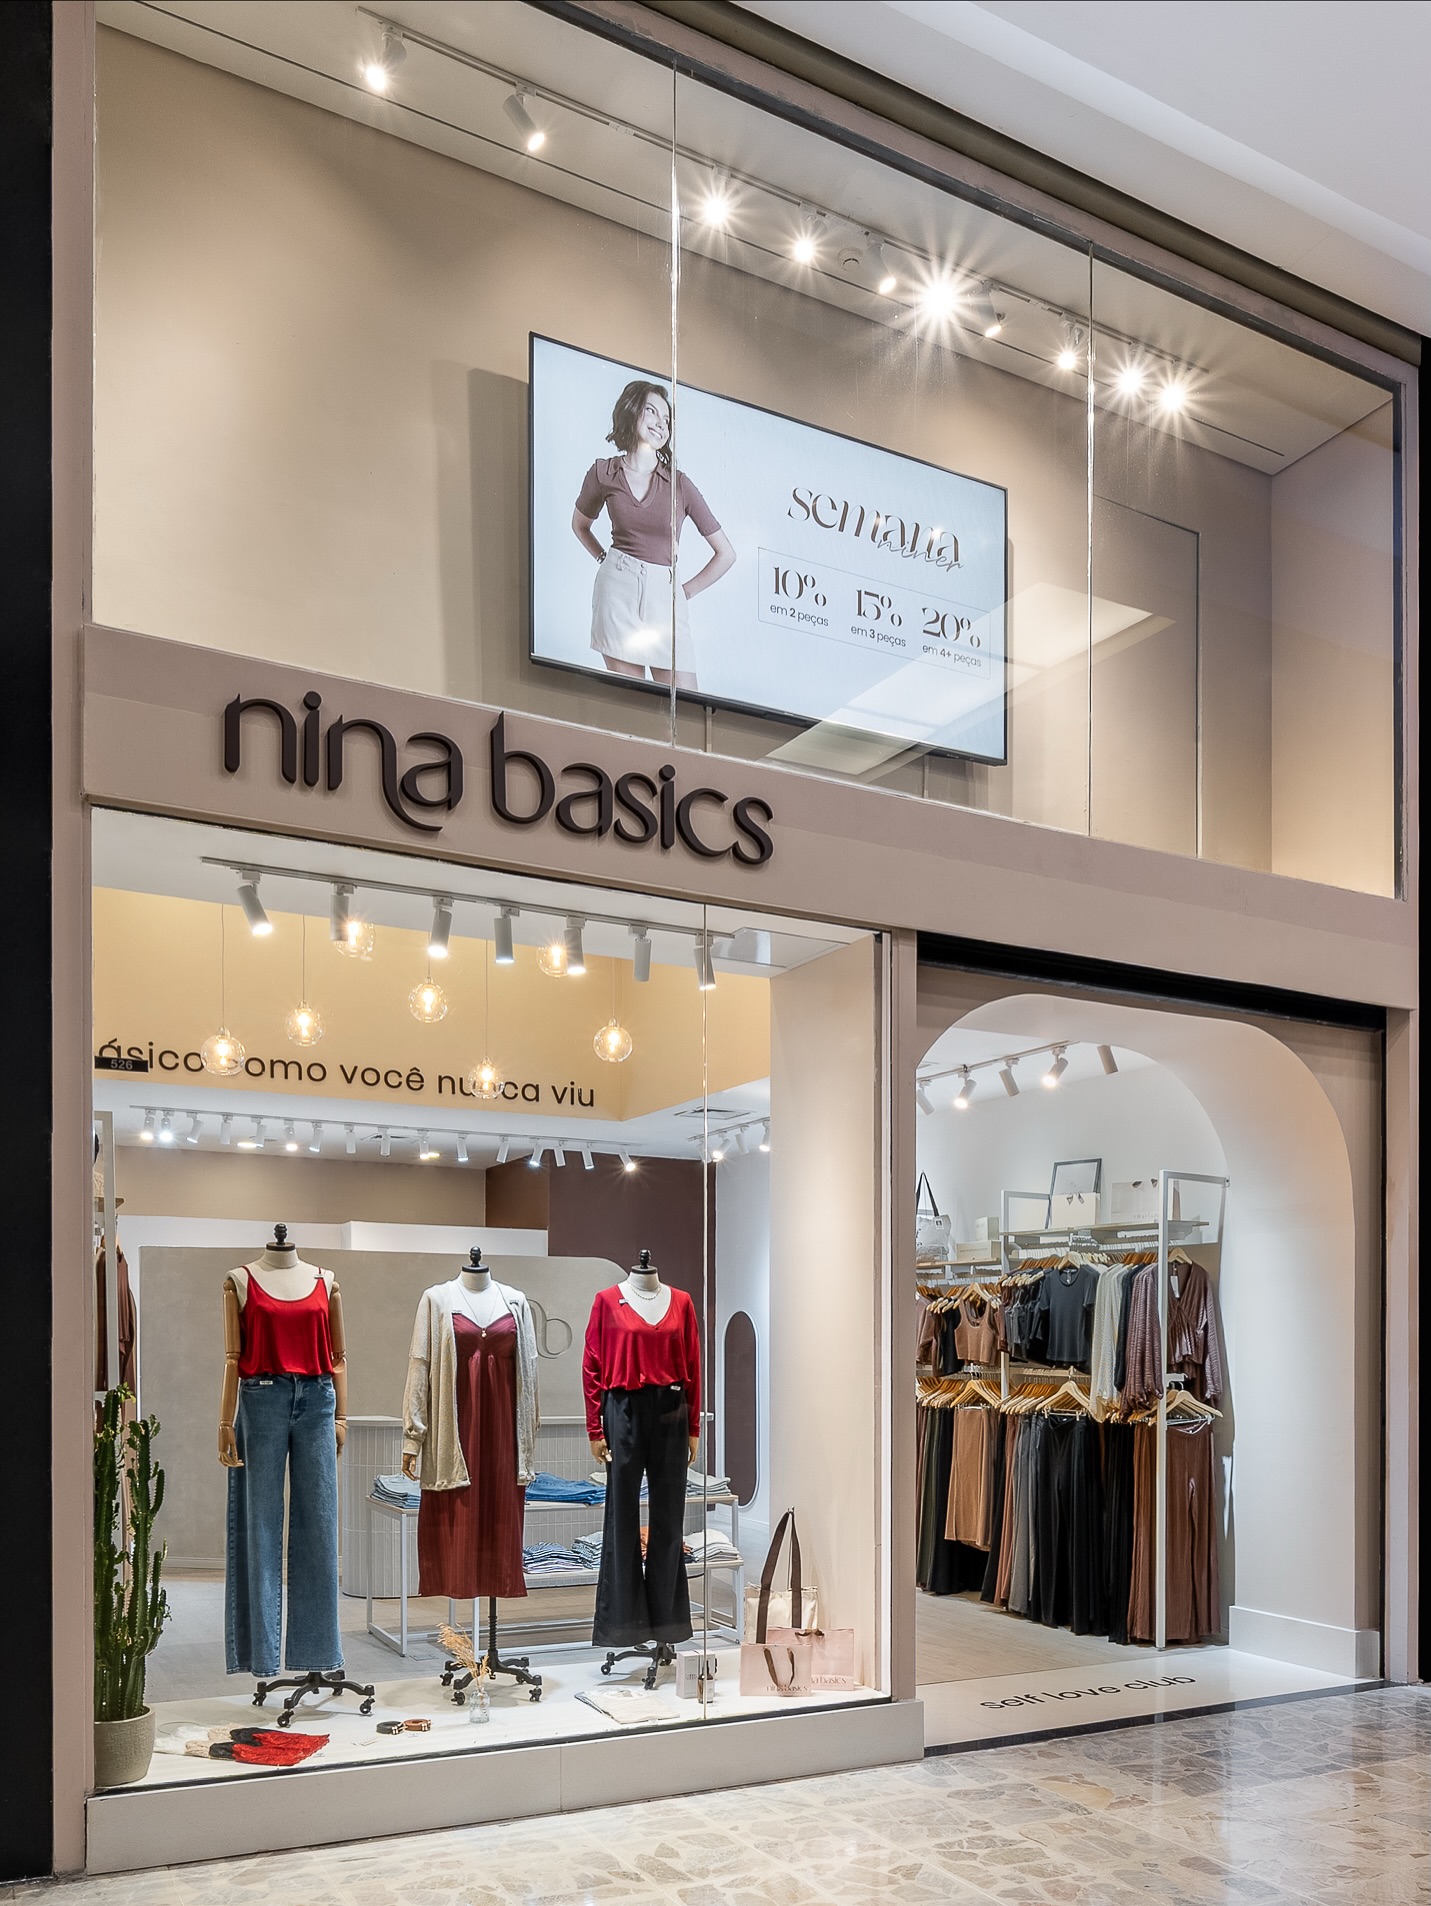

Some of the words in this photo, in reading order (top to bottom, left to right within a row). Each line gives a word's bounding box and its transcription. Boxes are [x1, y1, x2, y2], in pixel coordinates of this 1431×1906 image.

[787, 487, 960, 563] semana
[773, 566, 827, 607] 10%
[769, 603, 788, 616] em
[789, 607, 796, 618] 2
[797, 610, 829, 627] peças
[855, 589, 903, 627] 15%
[850, 625, 868, 637] em
[869, 628, 876, 639] 3
[876, 631, 907, 648] peças
[921, 607, 981, 649] 20%
[922, 644, 938, 655] em
[939, 648, 952, 658] 4+
[953, 651, 982, 668] peças
[224, 690, 464, 832] nina
[490, 710, 774, 864] basics
[110, 1058, 133, 1071] 526
[339, 1066, 425, 1091] você
[551, 1080, 595, 1107] viu
[980, 1693, 1045, 1709] self
[1041, 1686, 1121, 1700] love
[1124, 1676, 1196, 1690] club
